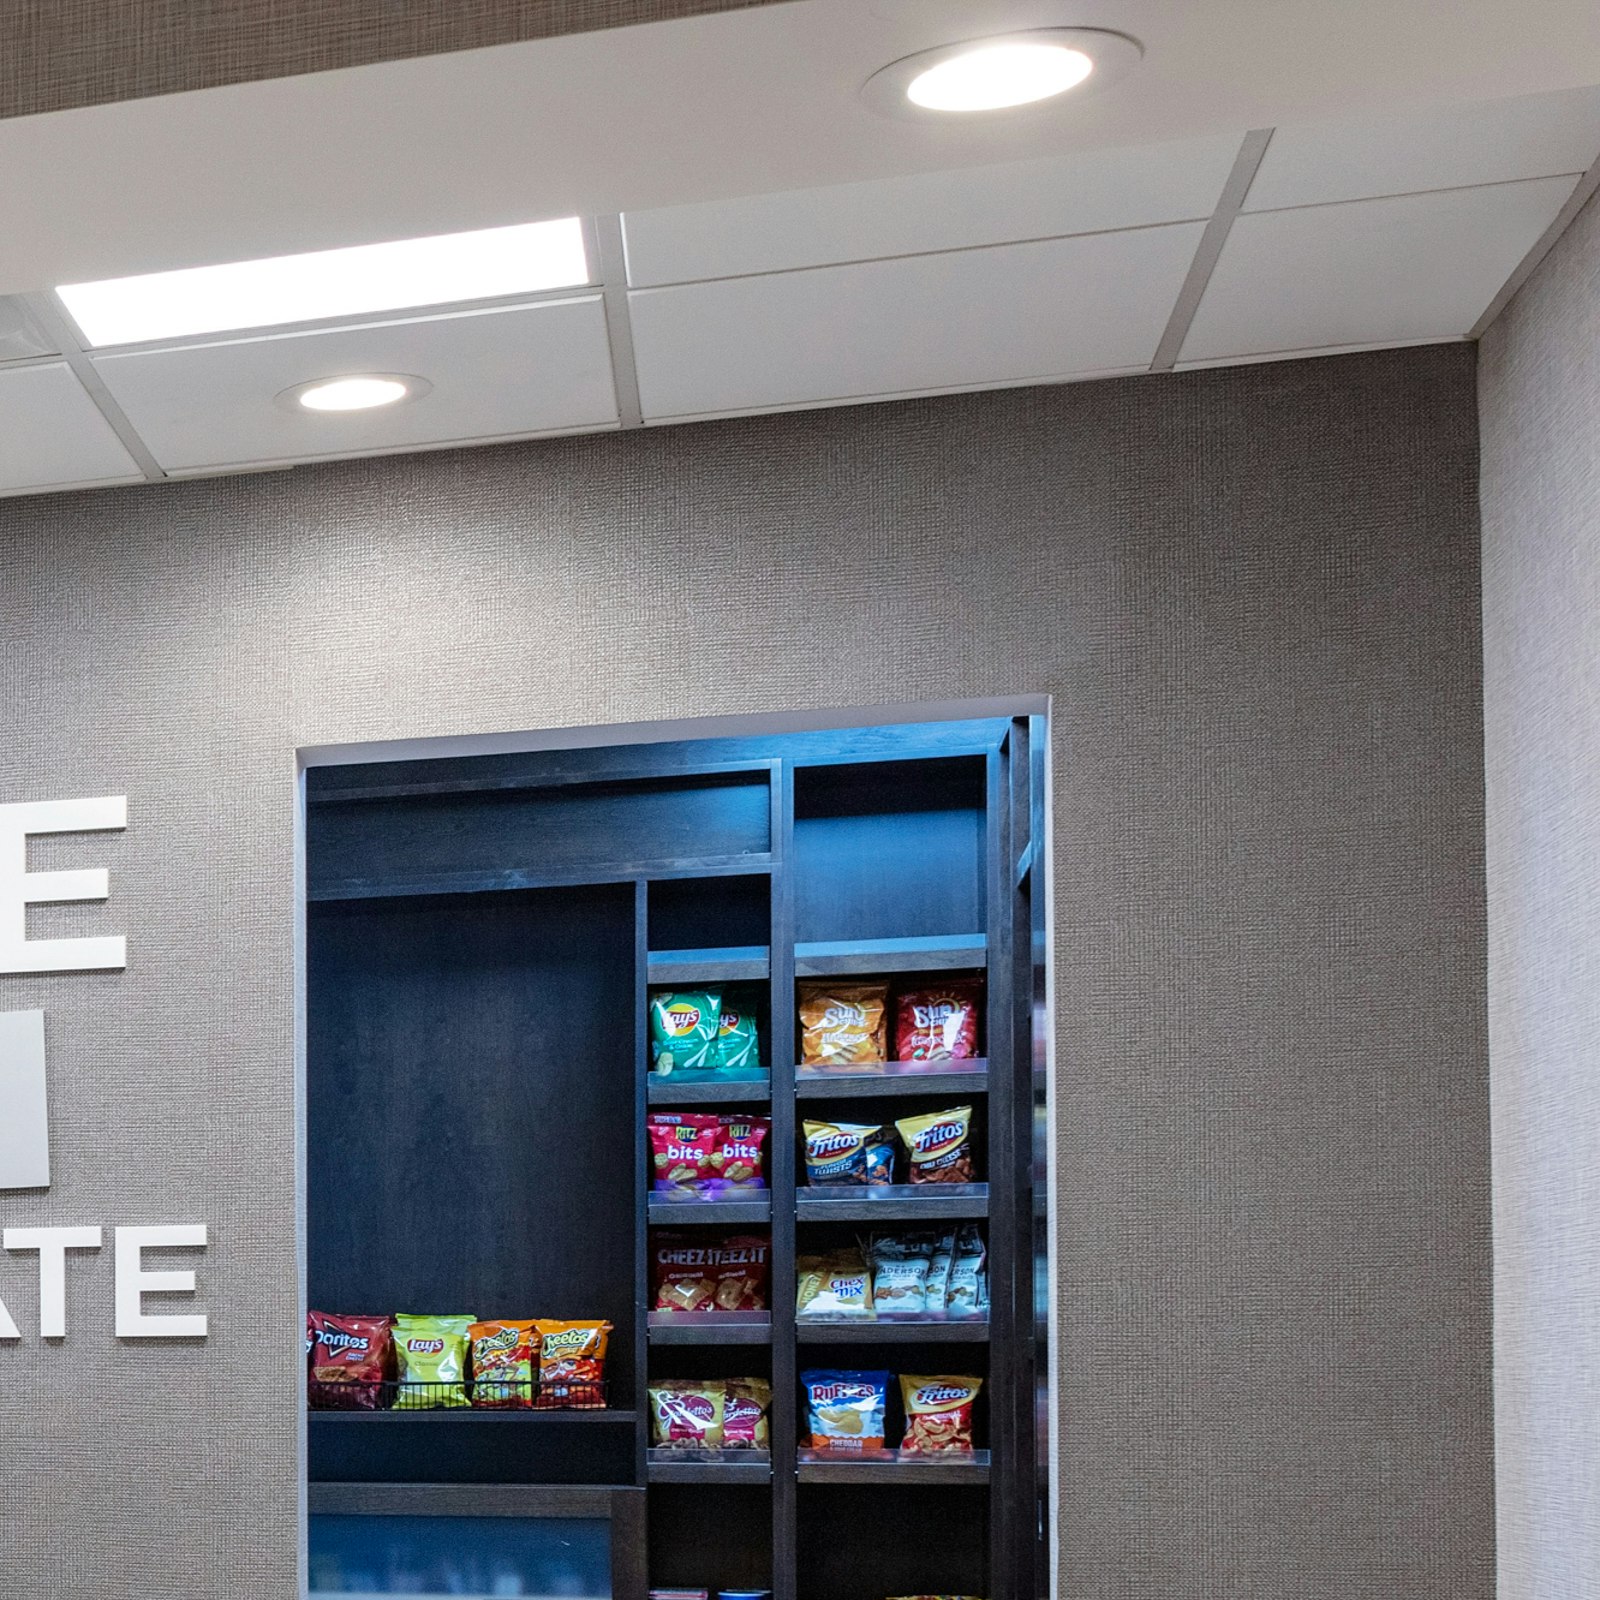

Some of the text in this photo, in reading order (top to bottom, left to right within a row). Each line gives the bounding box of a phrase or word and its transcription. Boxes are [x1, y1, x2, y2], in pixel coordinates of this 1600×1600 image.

[664, 1008, 699, 1029] ay's
[676, 1126, 698, 1140] RITZ
[729, 1124, 751, 1137] RITZ
[912, 1121, 964, 1153] Fritos
[667, 1145, 704, 1159] bits
[722, 1143, 758, 1158] bits
[807, 1132, 860, 1157] Fritos
[721, 1246, 767, 1264] EEZ-IT
[830, 1276, 865, 1290] Chex
[314, 1329, 369, 1350] Doritos
[409, 1339, 443, 1354] Lay's
[542, 1328, 589, 1357] Cheetos
[917, 1386, 970, 1405] Fritos
